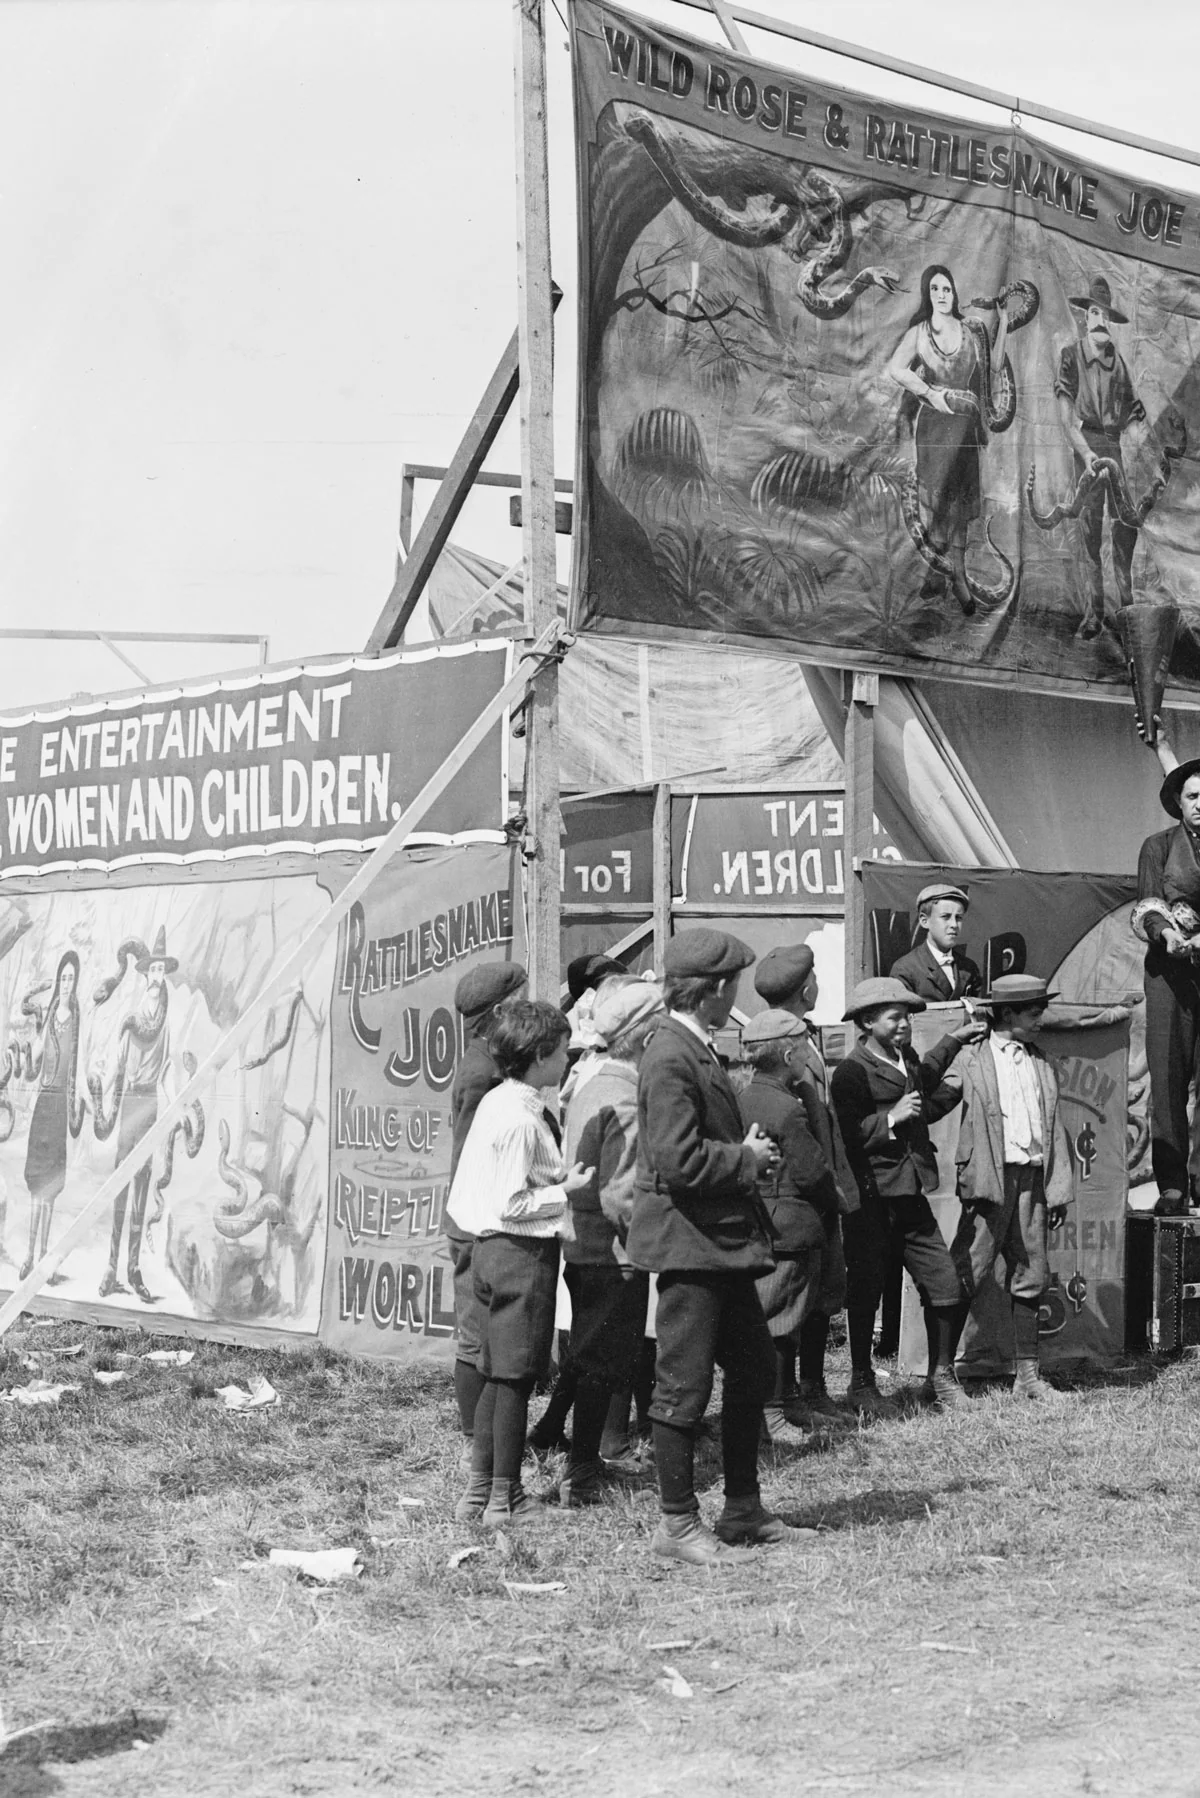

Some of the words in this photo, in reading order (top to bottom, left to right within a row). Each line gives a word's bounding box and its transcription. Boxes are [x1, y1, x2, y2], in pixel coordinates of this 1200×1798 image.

[601, 25, 694, 99] WILD
[704, 64, 807, 140] ROSE
[823, 103, 849, 151] &
[864, 114, 1098, 221] RATTLESNAKE
[1115, 191, 1186, 247] JOE
[40, 682, 352, 778] ENTERTAINMENT
[6, 784, 120, 855] WOMEN
[125, 777, 194, 841] AND
[201, 753, 401, 838] CHILDREN.
[339, 890, 515, 1053] RATTLESNAKE
[384, 1007, 466, 1091] JO
[1056, 1057, 1118, 1103] SION
[336, 1087, 402, 1153] KING
[404, 1110, 442, 1153] OF
[334, 1172, 450, 1247] REPTI
[1049, 1219, 1117, 1252] DREN
[339, 1256, 460, 1340] WORL
